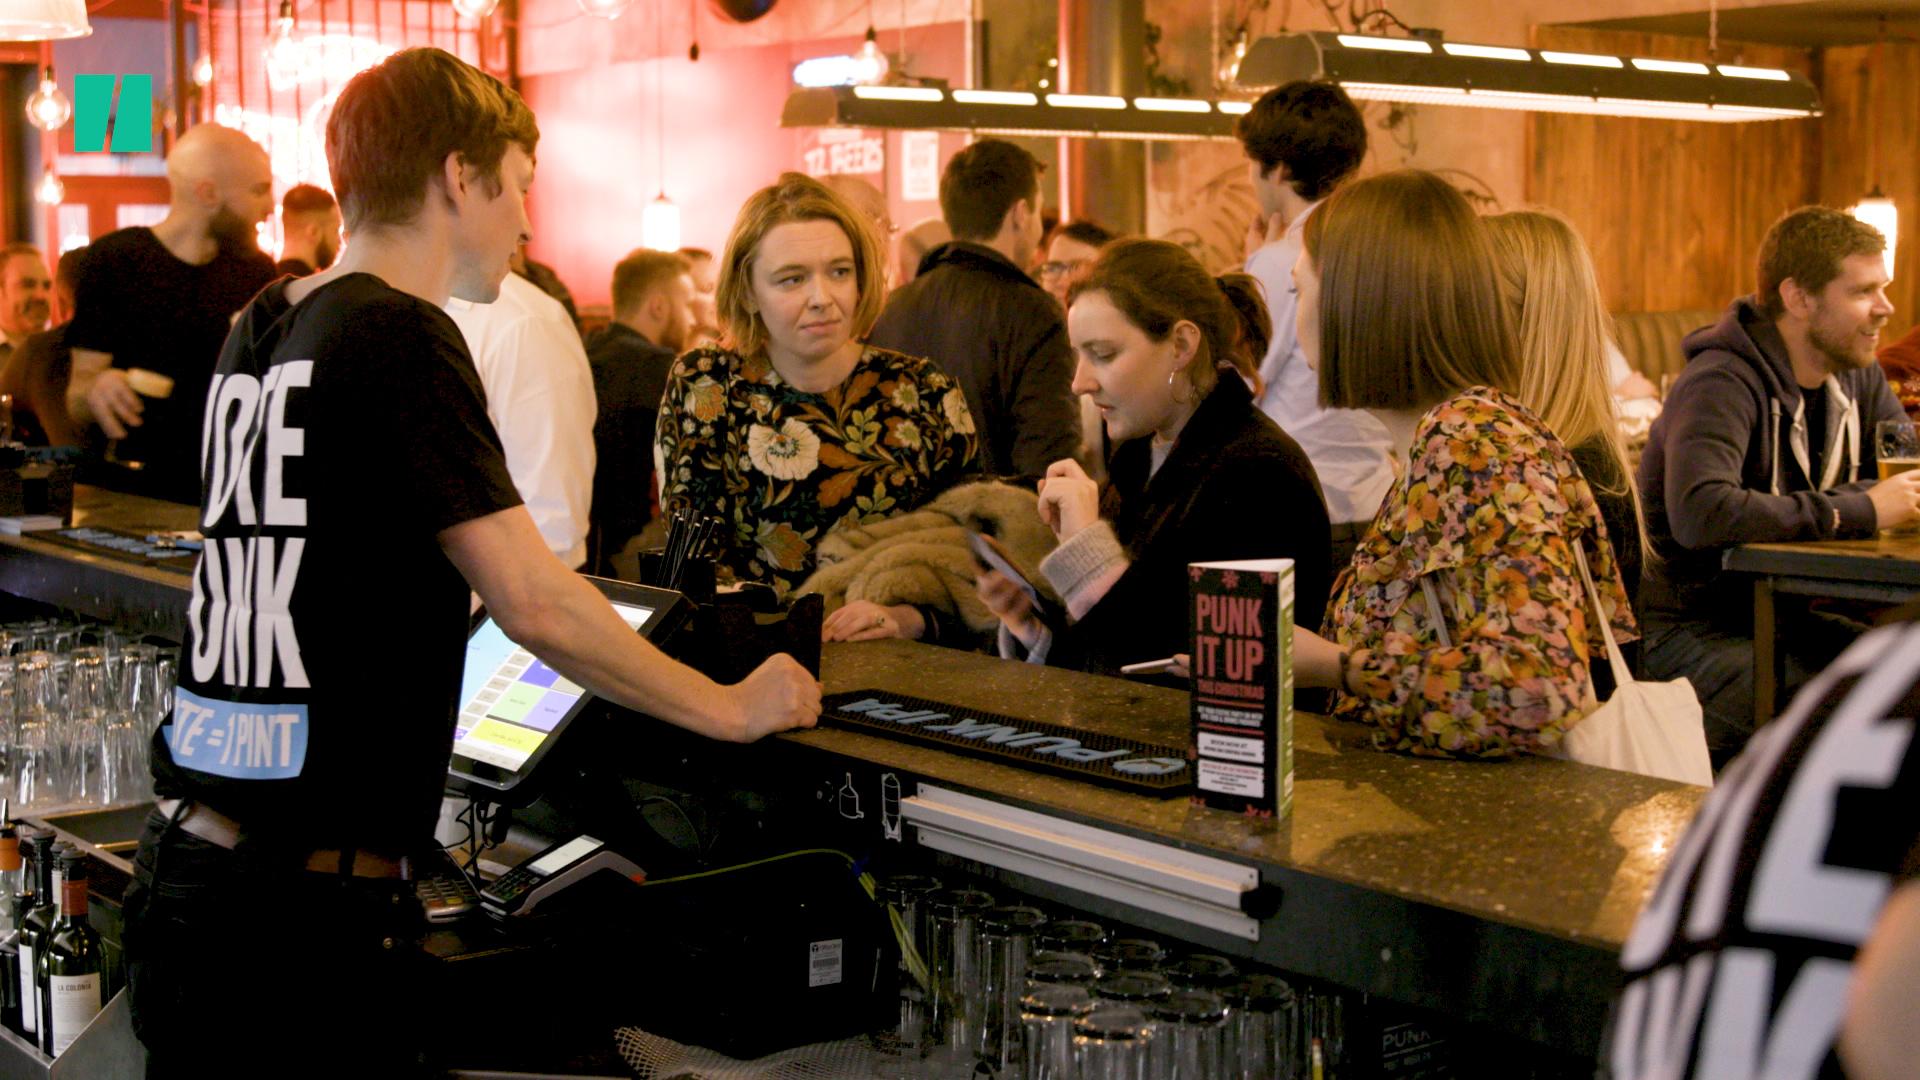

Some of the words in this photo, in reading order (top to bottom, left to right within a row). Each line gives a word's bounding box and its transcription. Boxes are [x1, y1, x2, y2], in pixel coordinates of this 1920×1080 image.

[188, 536, 311, 688] UNK
[1196, 593, 1263, 638] PUNK
[1196, 634, 1220, 677] IT
[1224, 638, 1265, 682] UP
[838, 698, 951, 724] IPA
[173, 703, 215, 757] TE
[233, 714, 299, 768] PINT
[923, 718, 1131, 762] PUNK
[65, 983, 92, 992] COLONIA
